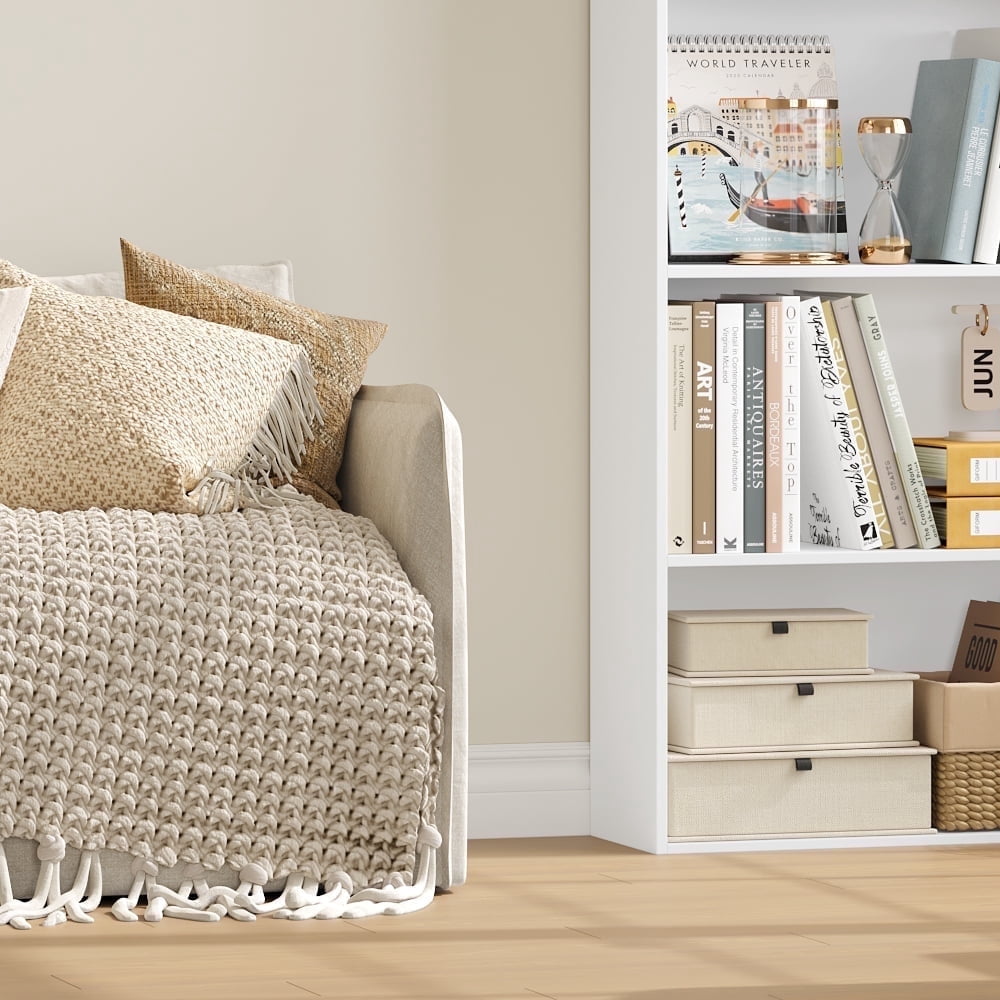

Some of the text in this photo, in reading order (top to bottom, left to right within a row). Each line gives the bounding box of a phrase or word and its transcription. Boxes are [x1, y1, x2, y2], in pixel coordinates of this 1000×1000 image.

[687, 59, 811, 68] WORLD TRAVELER
[721, 327, 729, 354] Virginia
[731, 326, 739, 346] Detail
[868, 314, 882, 341] GRAY
[677, 380, 685, 408] Knitting
[697, 361, 713, 401] ART
[730, 360, 739, 406] Contemporary
[877, 350, 904, 418] JASPER JOHNS
[974, 349, 993, 398] JUN
[823, 394, 842, 407] of
[731, 409, 739, 448] Residential
[750, 365, 764, 489] ANTIQUAIRES
[769, 402, 780, 468] BORDEAUX
[830, 411, 857, 461] Beauty
[731, 450, 739, 492] Architecture
[842, 463, 870, 518] Terrible
[906, 464, 932, 541] The Crosshatch Works
[965, 635, 998, 673] GOOD
